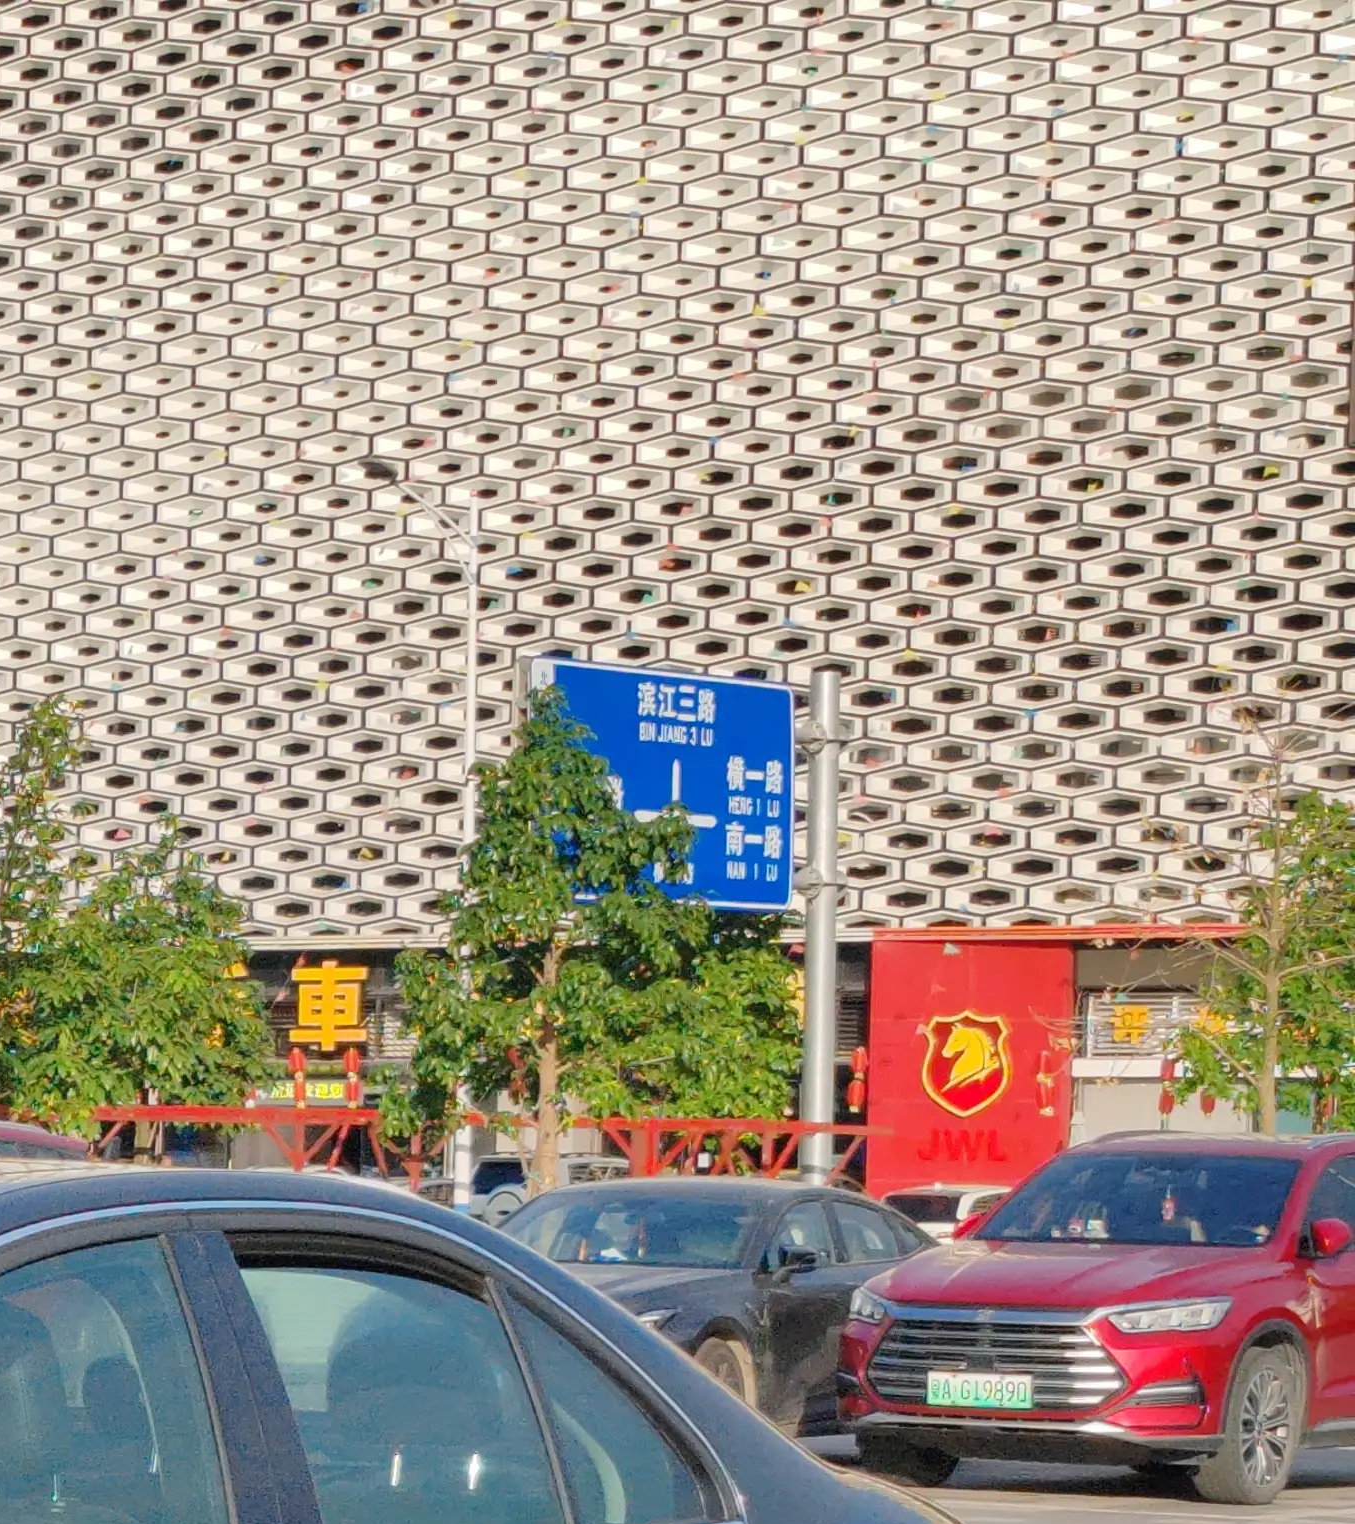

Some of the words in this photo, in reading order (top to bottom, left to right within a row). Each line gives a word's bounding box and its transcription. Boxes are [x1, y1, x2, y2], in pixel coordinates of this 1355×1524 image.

[637, 681, 716, 724] 滨江三路
[639, 721, 657, 742] BIN
[658, 723, 688, 745] JIANG
[700, 726, 714, 747] LU
[726, 754, 784, 795] 横一路
[724, 820, 784, 860] 南一路
[726, 860, 747, 880] NAN
[288, 959, 371, 1052] 車
[916, 1127, 1009, 1163] JWL
